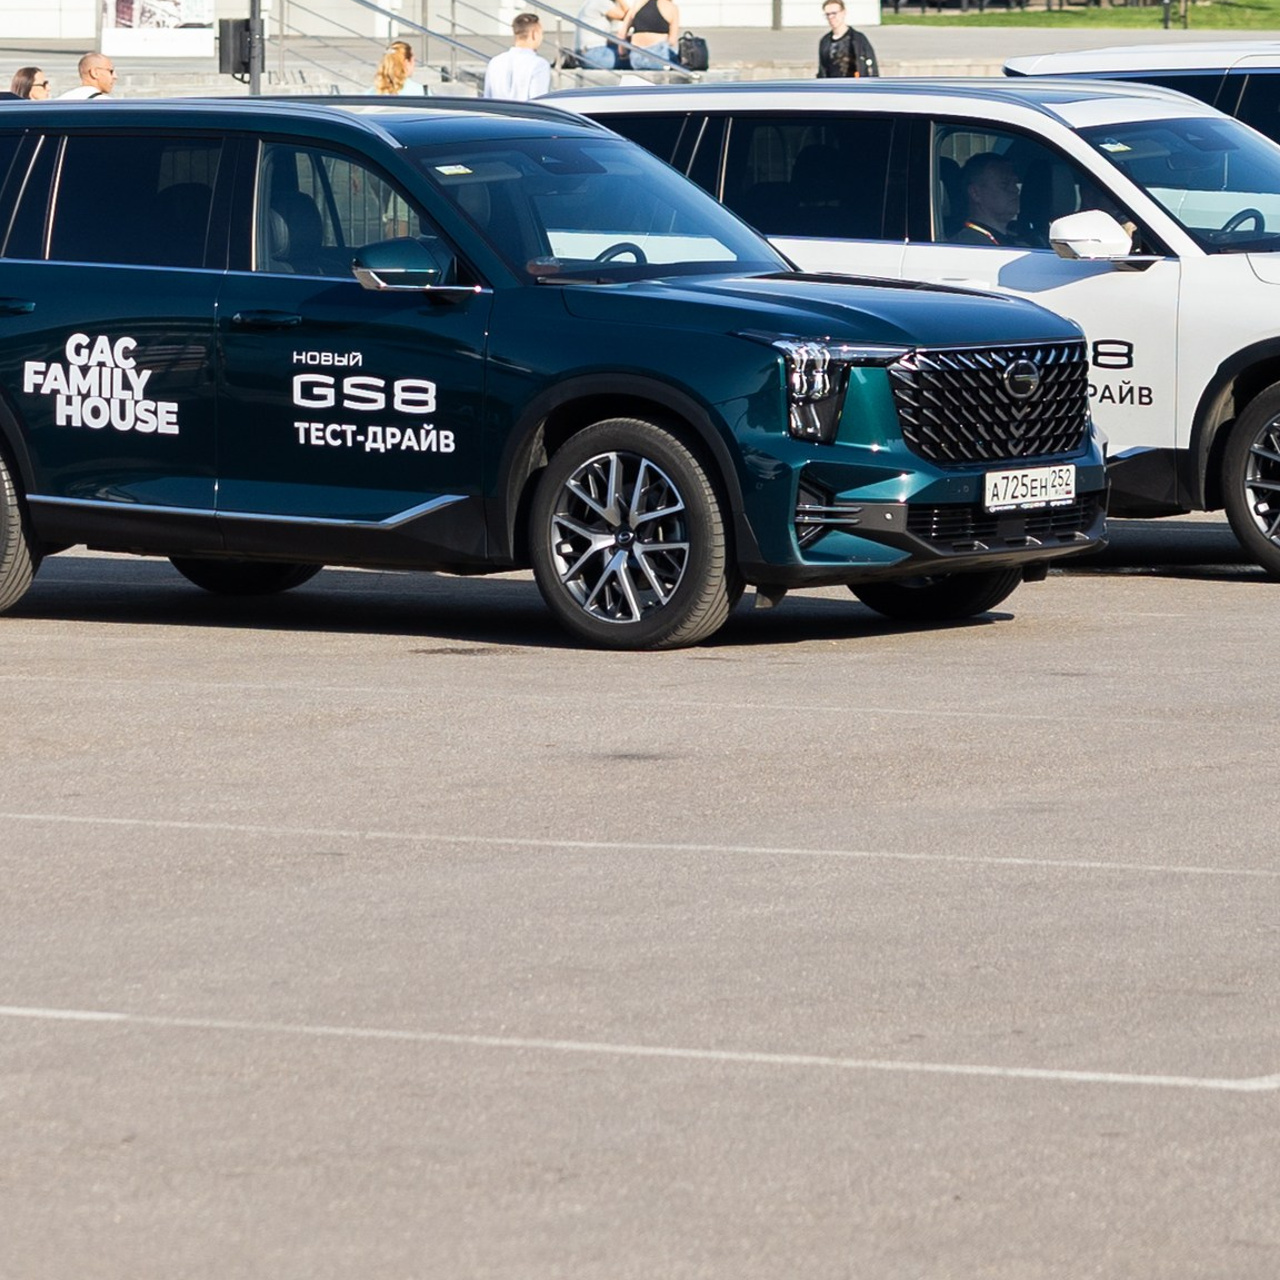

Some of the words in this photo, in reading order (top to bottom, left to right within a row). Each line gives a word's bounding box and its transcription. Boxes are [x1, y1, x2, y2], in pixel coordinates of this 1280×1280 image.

[65, 333, 137, 369] GAC
[23, 361, 152, 400] FAMILY
[293, 374, 436, 414] GS8
[55, 394, 180, 435] HOUSE
[294, 422, 456, 453] ТЕСТ-ДРАЙВ
[1050, 469, 1071, 488] 252
